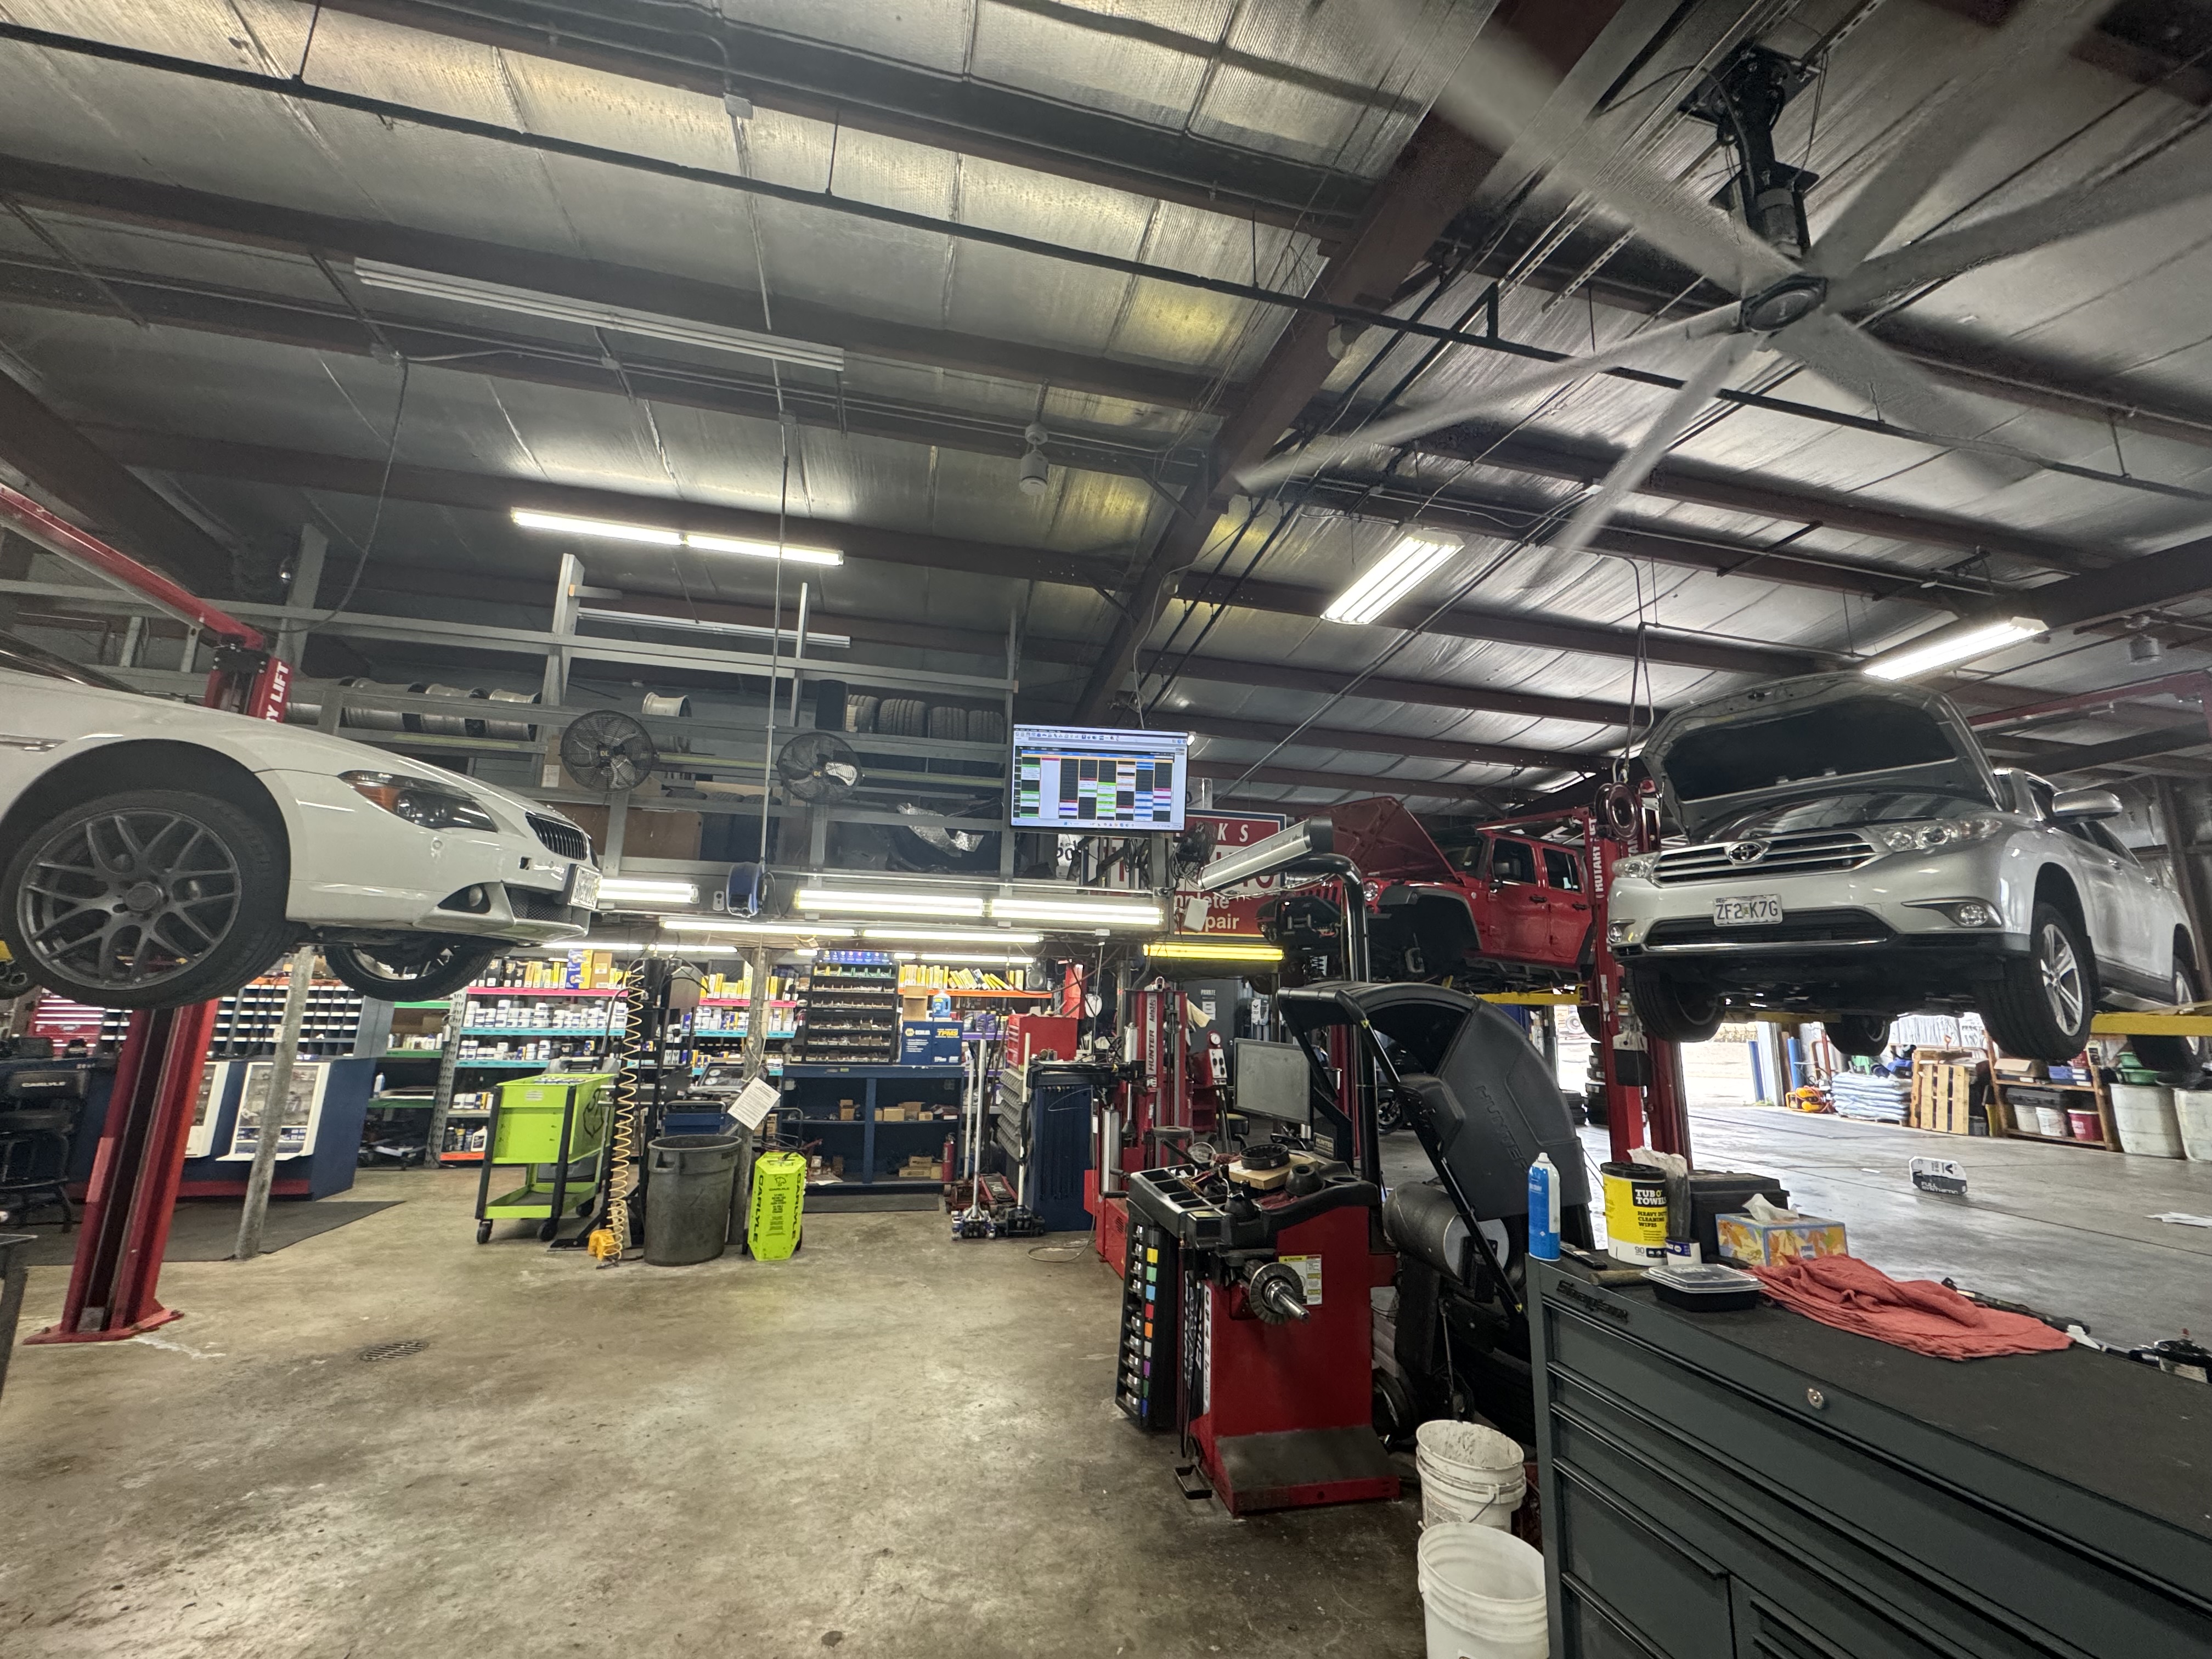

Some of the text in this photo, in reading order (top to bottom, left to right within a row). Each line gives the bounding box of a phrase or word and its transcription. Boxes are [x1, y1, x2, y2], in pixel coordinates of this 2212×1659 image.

[270, 661, 289, 703] LIFT
[1716, 900, 1778, 919] ZF2 K7G
[753, 1175, 764, 1242] CARLYLE
[792, 1173, 801, 1239] CARLYLE
